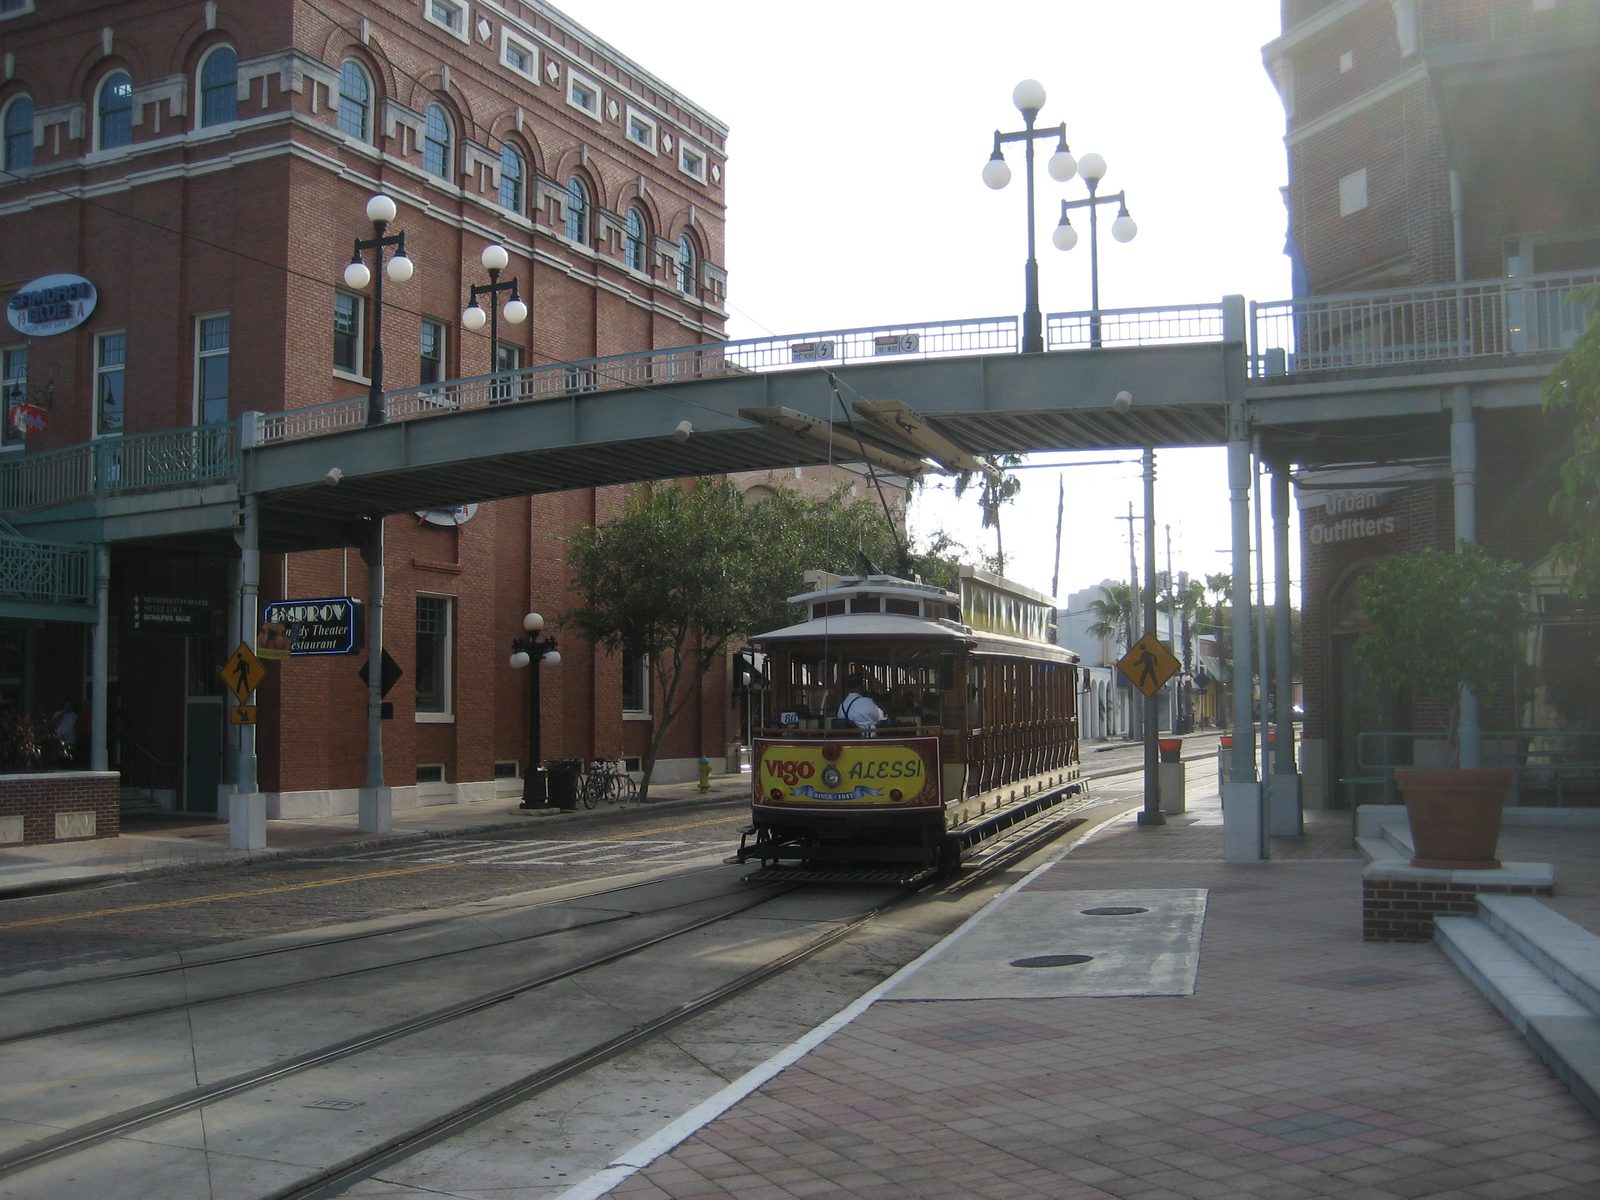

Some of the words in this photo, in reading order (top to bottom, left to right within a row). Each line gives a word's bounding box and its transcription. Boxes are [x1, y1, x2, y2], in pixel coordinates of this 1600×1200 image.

[28, 303, 71, 323] BLUE
[1326, 492, 1376, 515] Urban
[1311, 516, 1395, 545] Outfitters
[271, 604, 346, 624] IMPROV
[312, 625, 348, 636] Theater
[291, 640, 337, 650] estaurant
[849, 760, 921, 779] ALESSI
